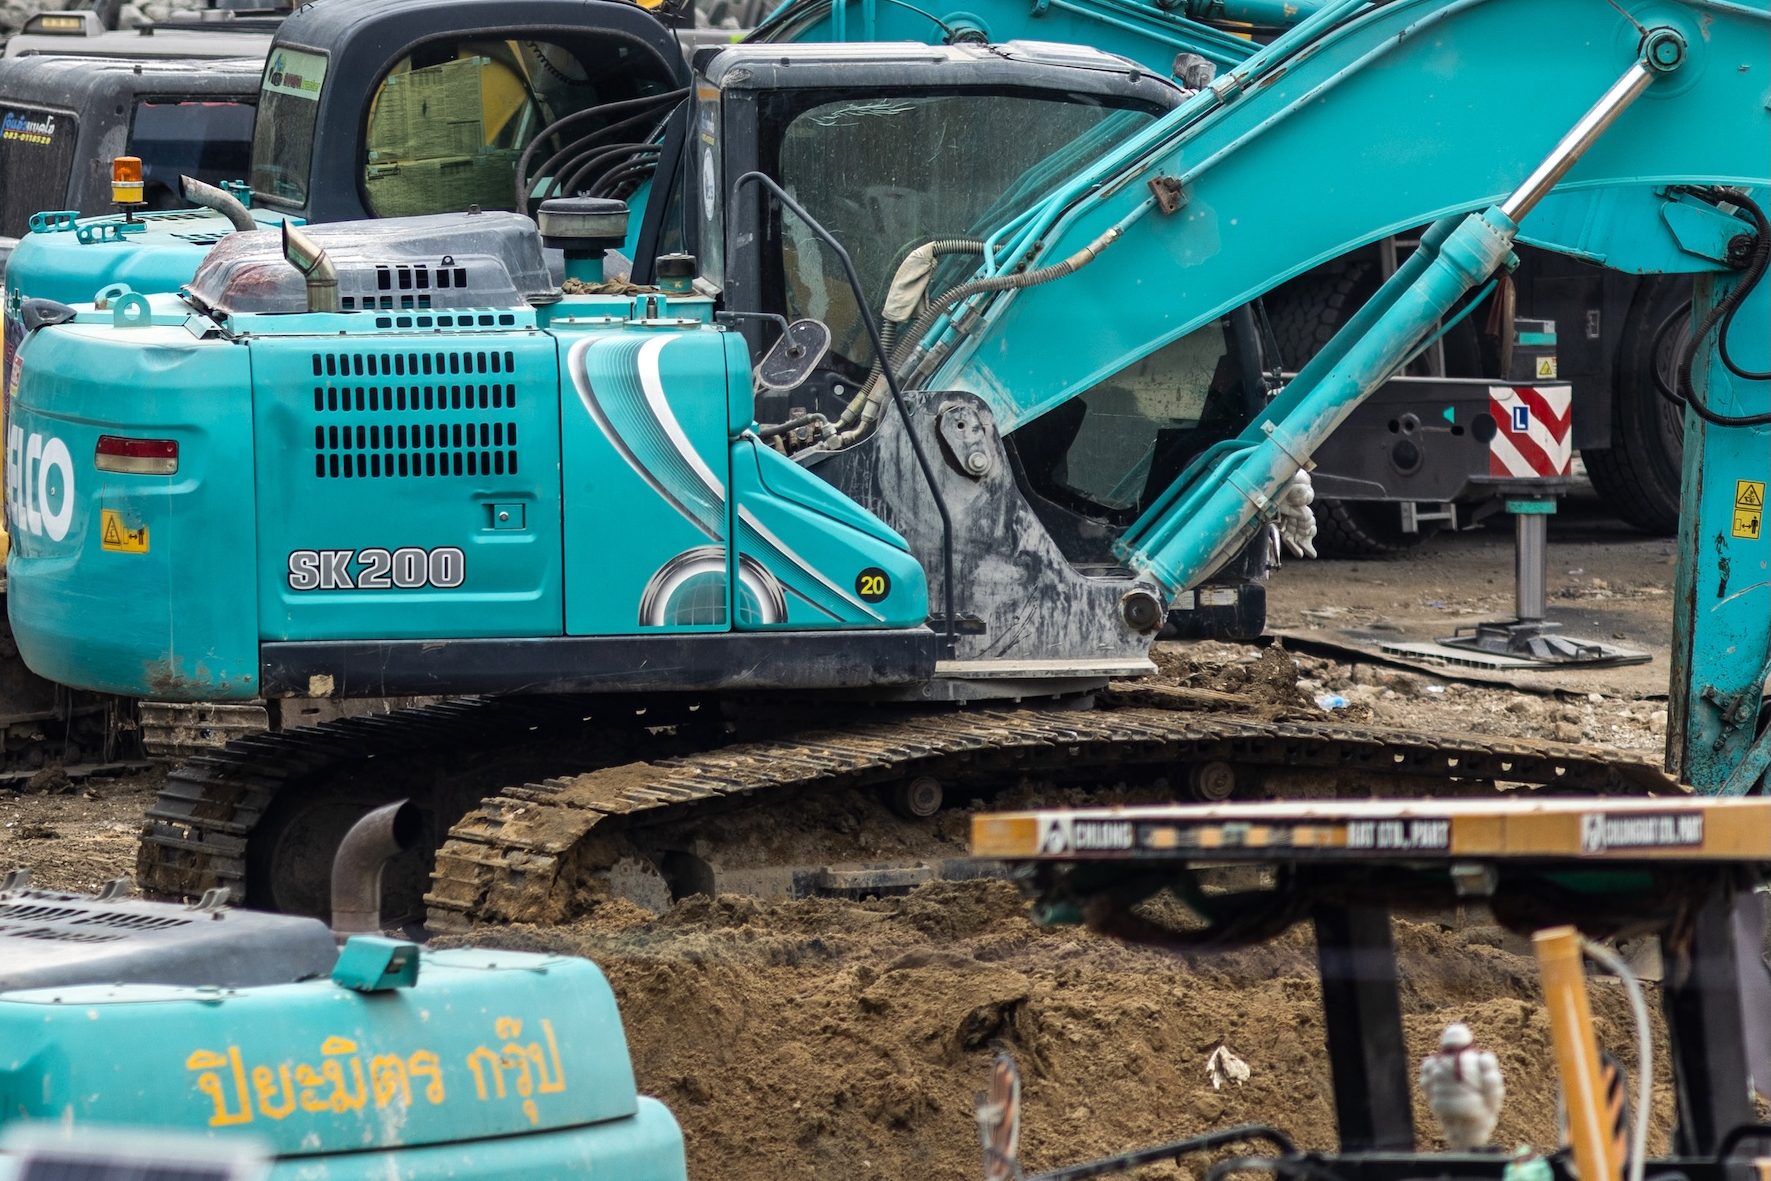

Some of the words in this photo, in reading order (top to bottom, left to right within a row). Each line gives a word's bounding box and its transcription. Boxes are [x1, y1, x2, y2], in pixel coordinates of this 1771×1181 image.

[1515, 408, 1527, 429] L
[288, 547, 466, 591] SK200
[859, 574, 888, 596] 20
[185, 1035, 447, 1127] ปิยะมิตร
[466, 1016, 567, 1125] กรุ๊ป
